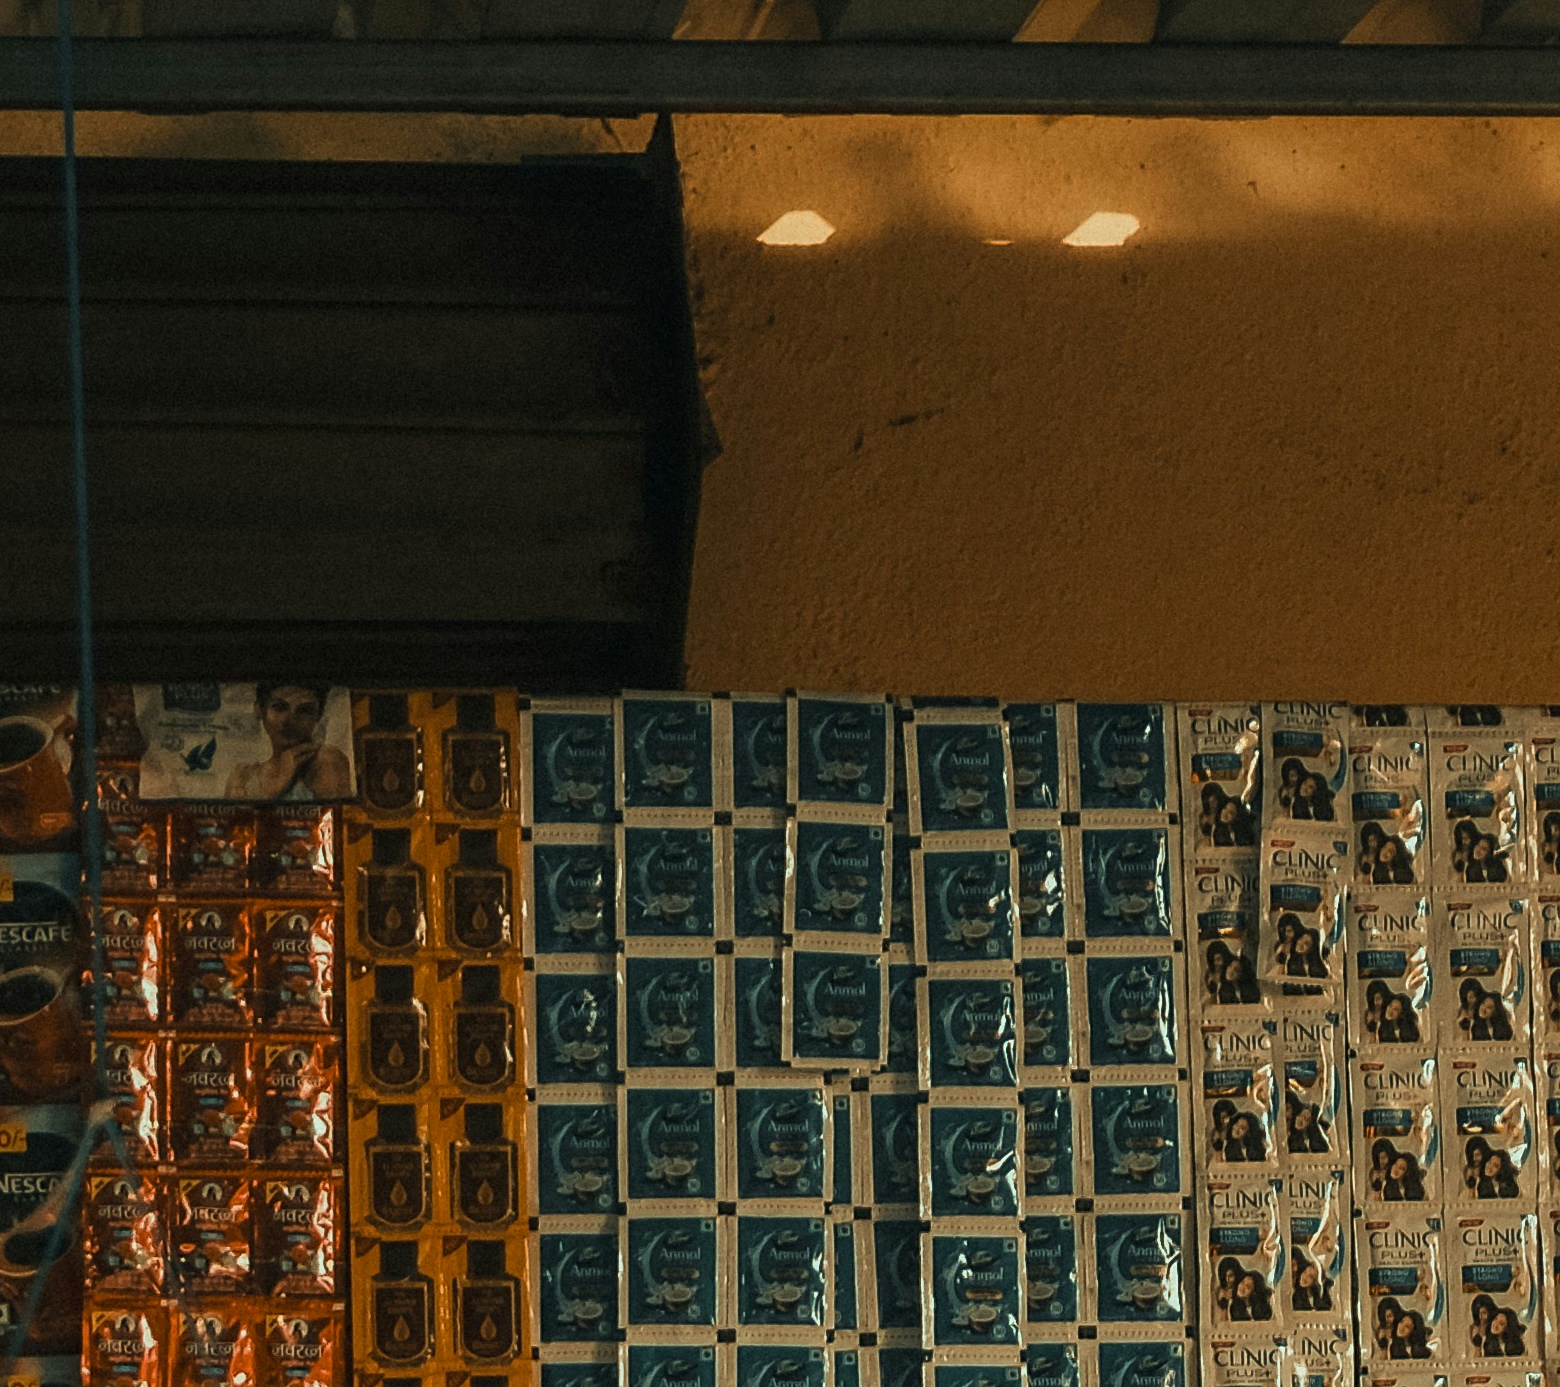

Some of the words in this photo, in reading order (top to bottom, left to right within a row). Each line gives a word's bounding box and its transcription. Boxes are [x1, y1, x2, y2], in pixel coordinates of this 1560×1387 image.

[1272, 849, 1339, 872] CLINIC
[1451, 911, 1517, 930] CLINIC
[1370, 1231, 1432, 1250] CLINIC
